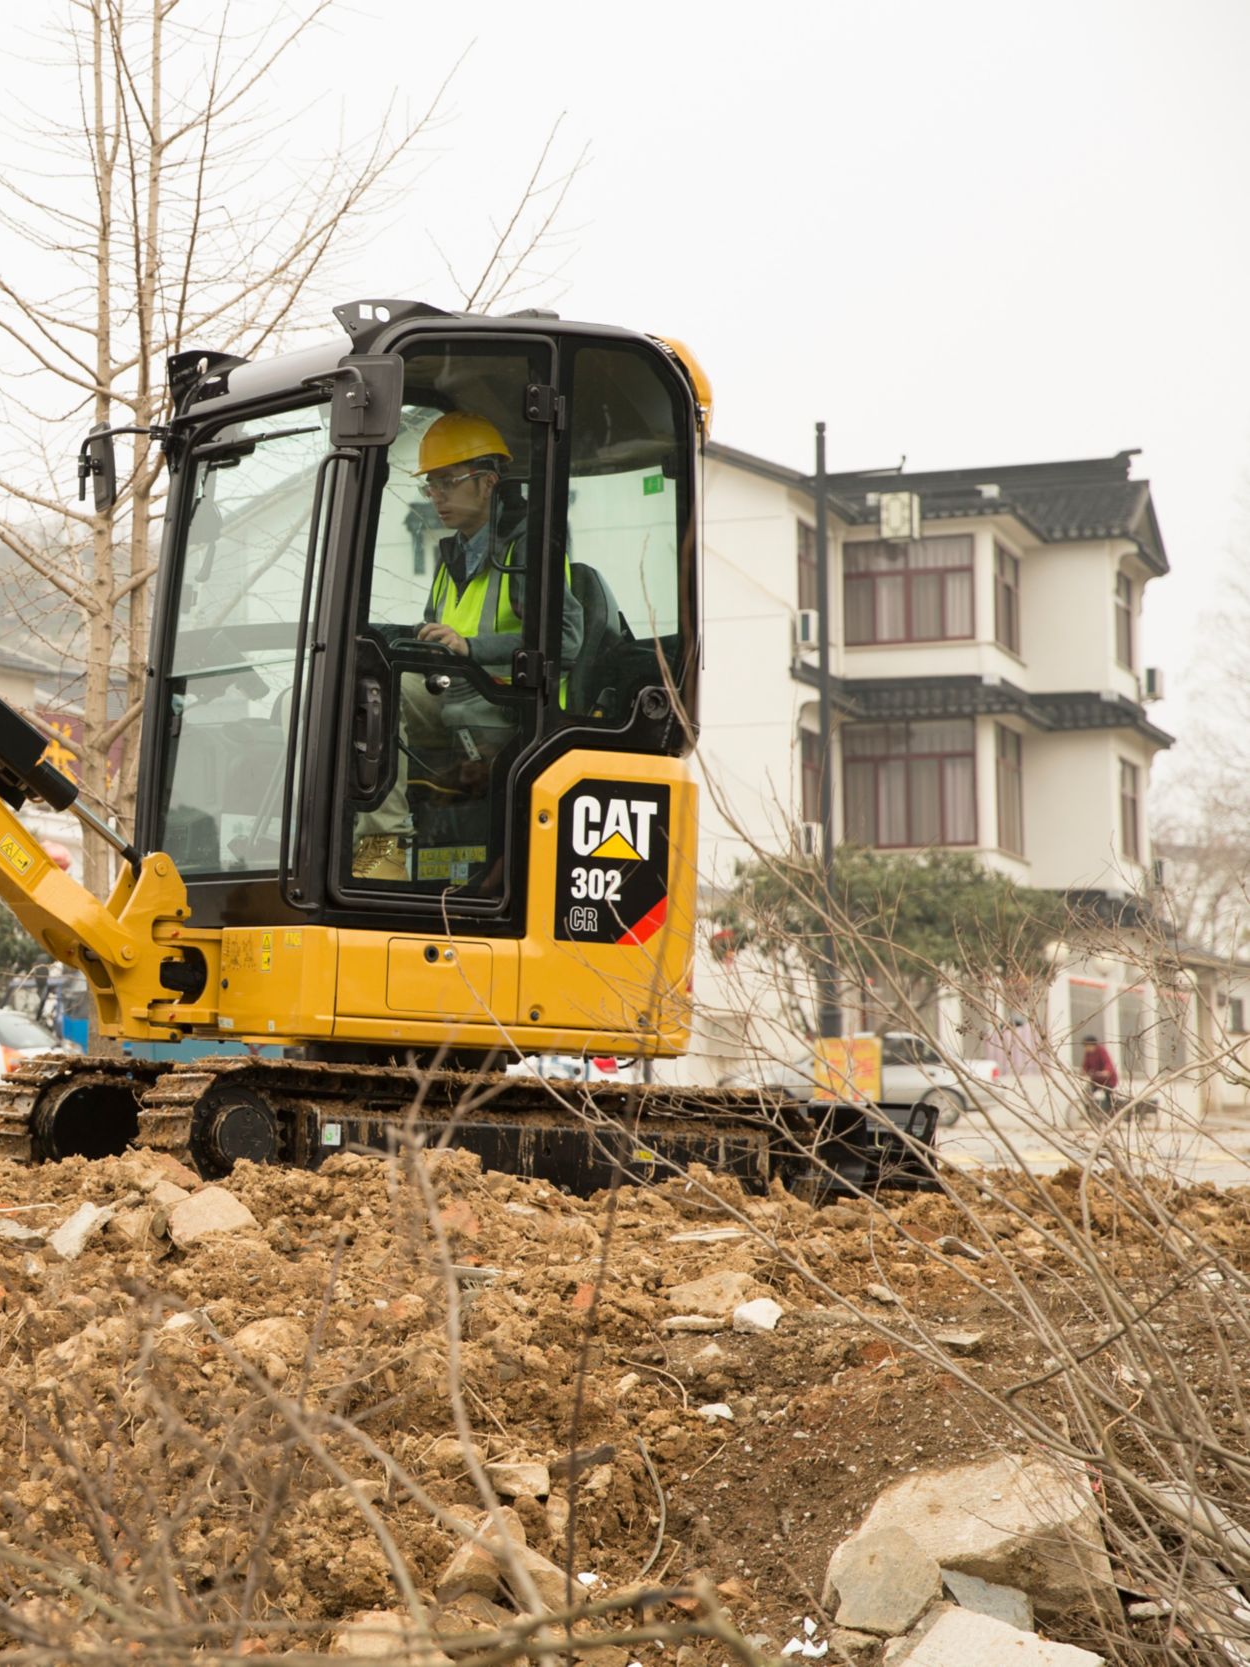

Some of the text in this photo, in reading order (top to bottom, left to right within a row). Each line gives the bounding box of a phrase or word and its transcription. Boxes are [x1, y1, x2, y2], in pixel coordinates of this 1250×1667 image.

[572, 795, 658, 861] CAT
[570, 867, 622, 901] 302
[569, 905, 598, 932] CR
